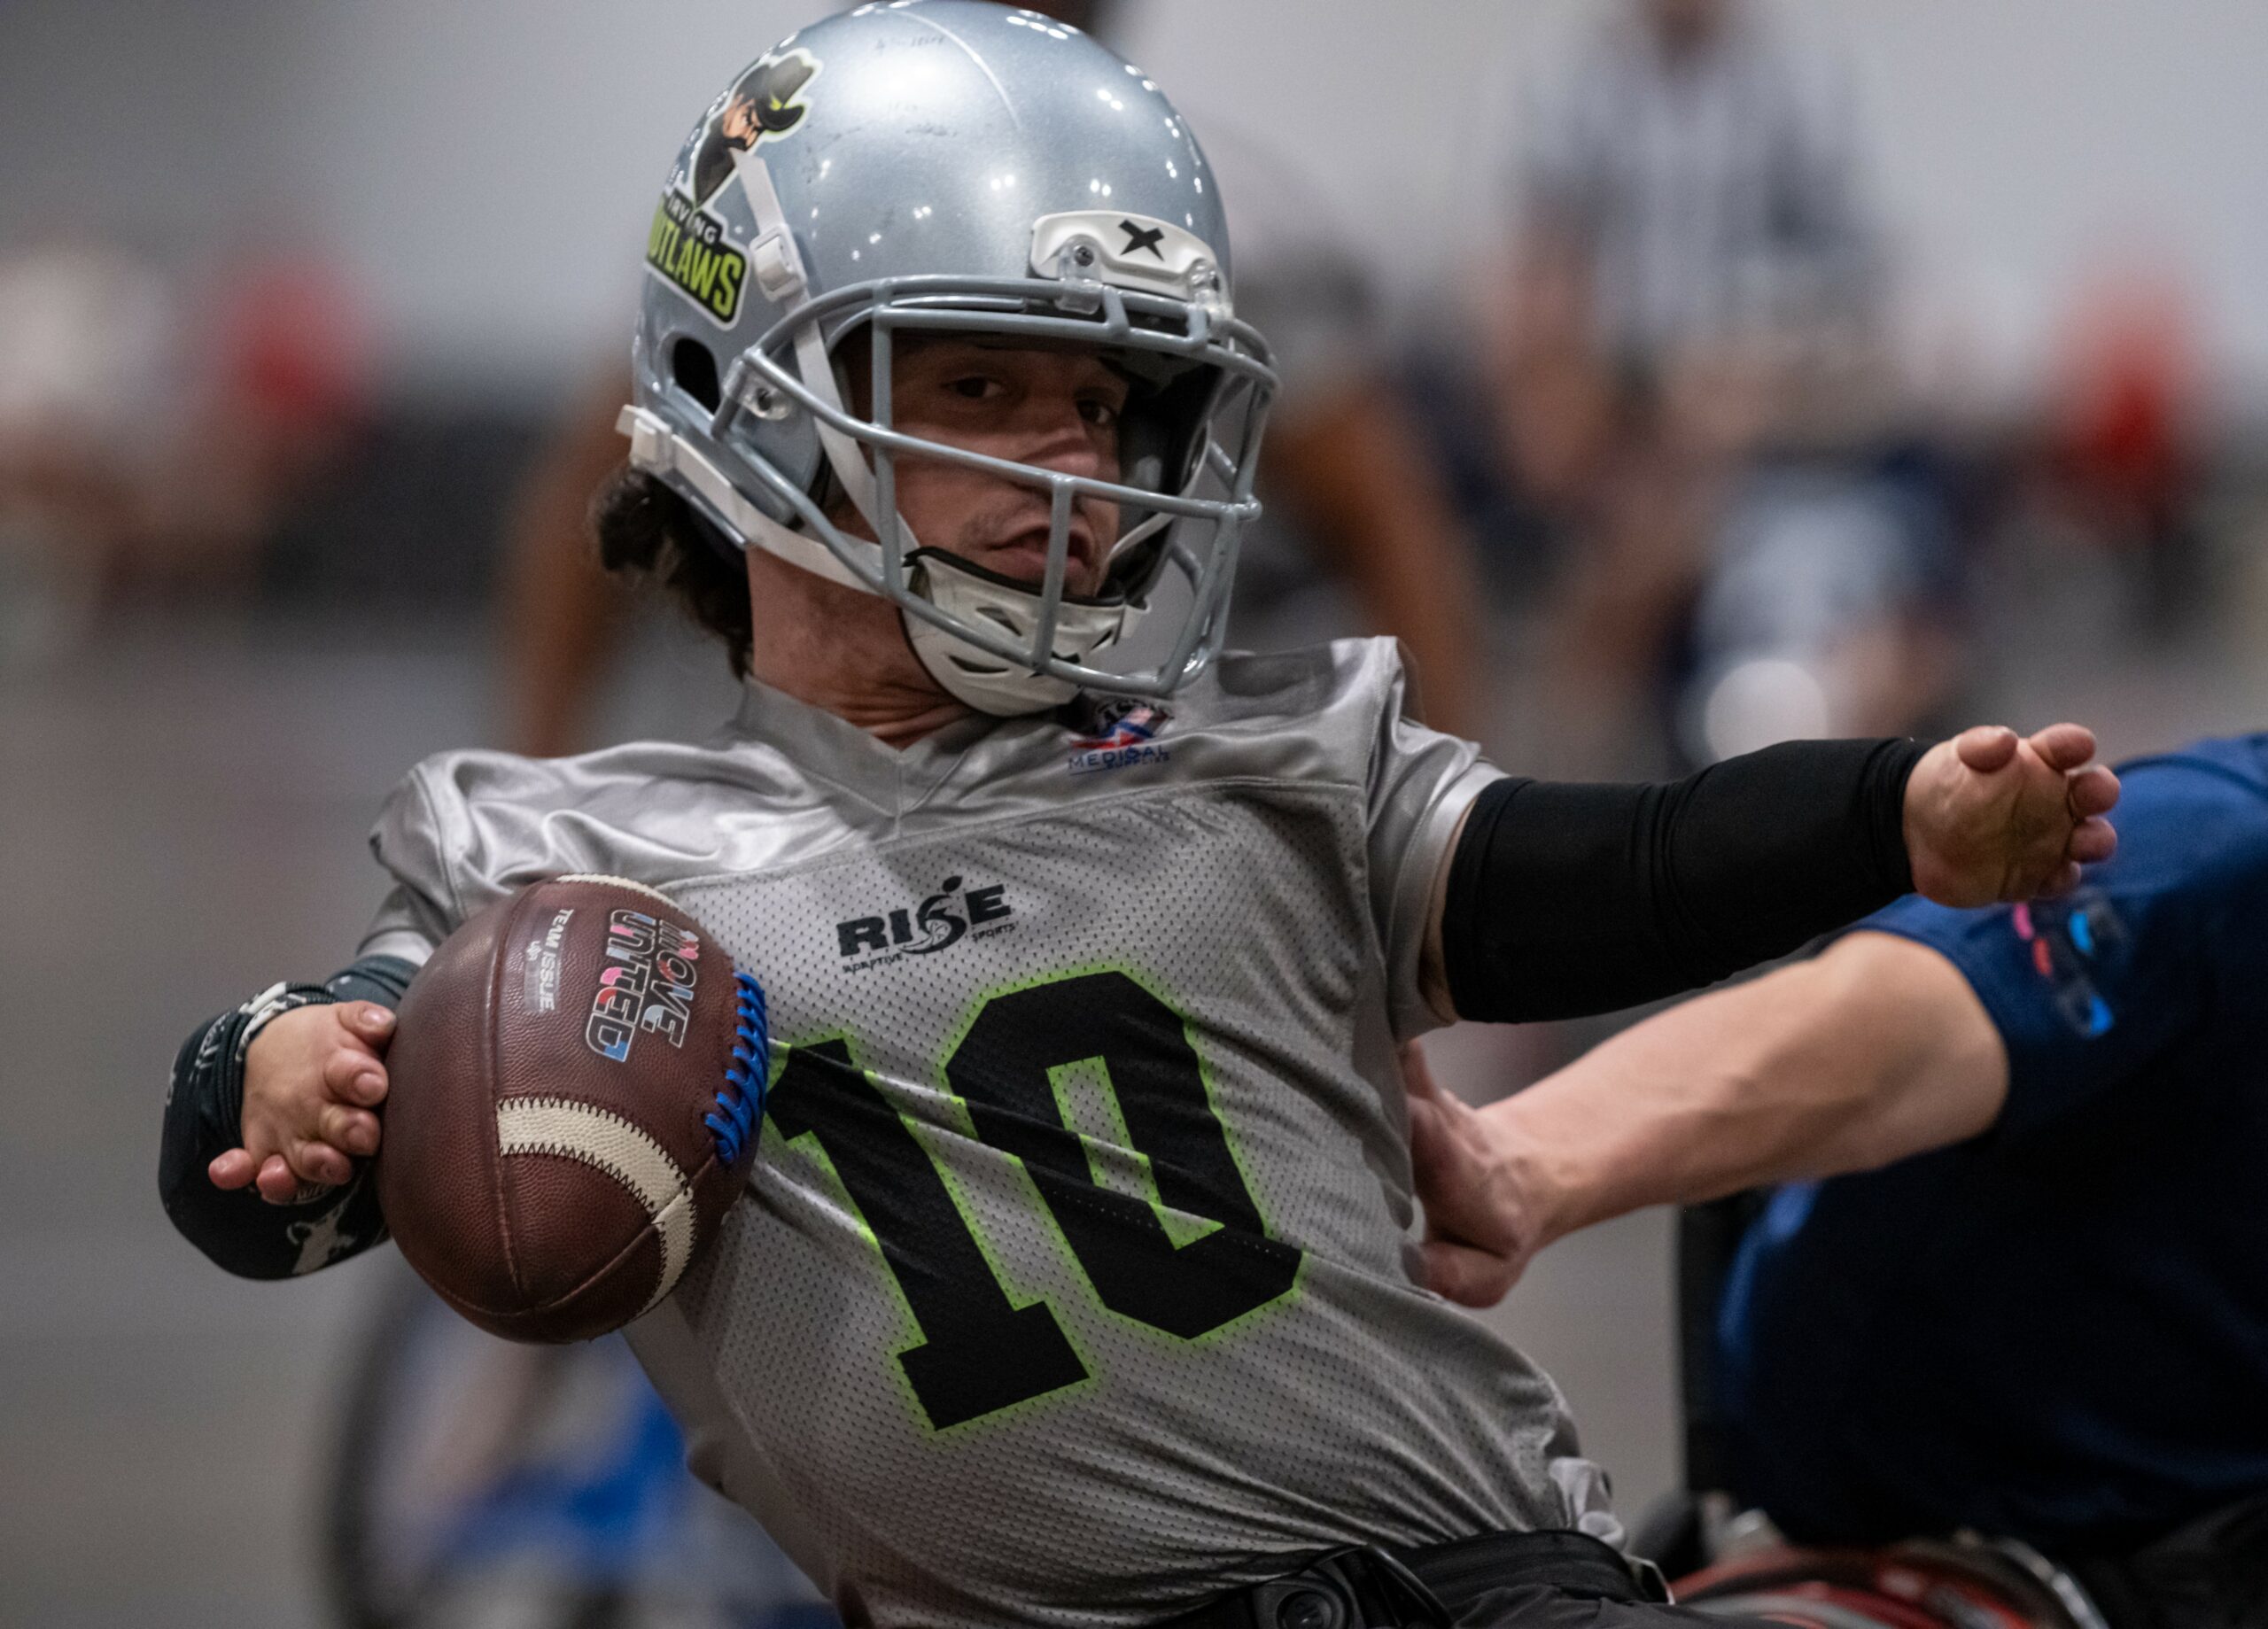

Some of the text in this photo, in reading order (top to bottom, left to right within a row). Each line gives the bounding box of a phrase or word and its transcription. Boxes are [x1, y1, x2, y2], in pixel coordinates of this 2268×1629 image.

[666, 194, 718, 244] IRVING
[1068, 744, 1167, 770] MEDICAL
[836, 875, 1012, 957] RISE
[972, 922, 1016, 942] SPORTS
[539, 909, 574, 1012] TEAM ISSUE
[586, 909, 656, 1063] UNITED
[641, 919, 699, 1049] MOVE
[842, 953, 904, 974] ADAPTIVE
[765, 969, 1303, 1432] 10
